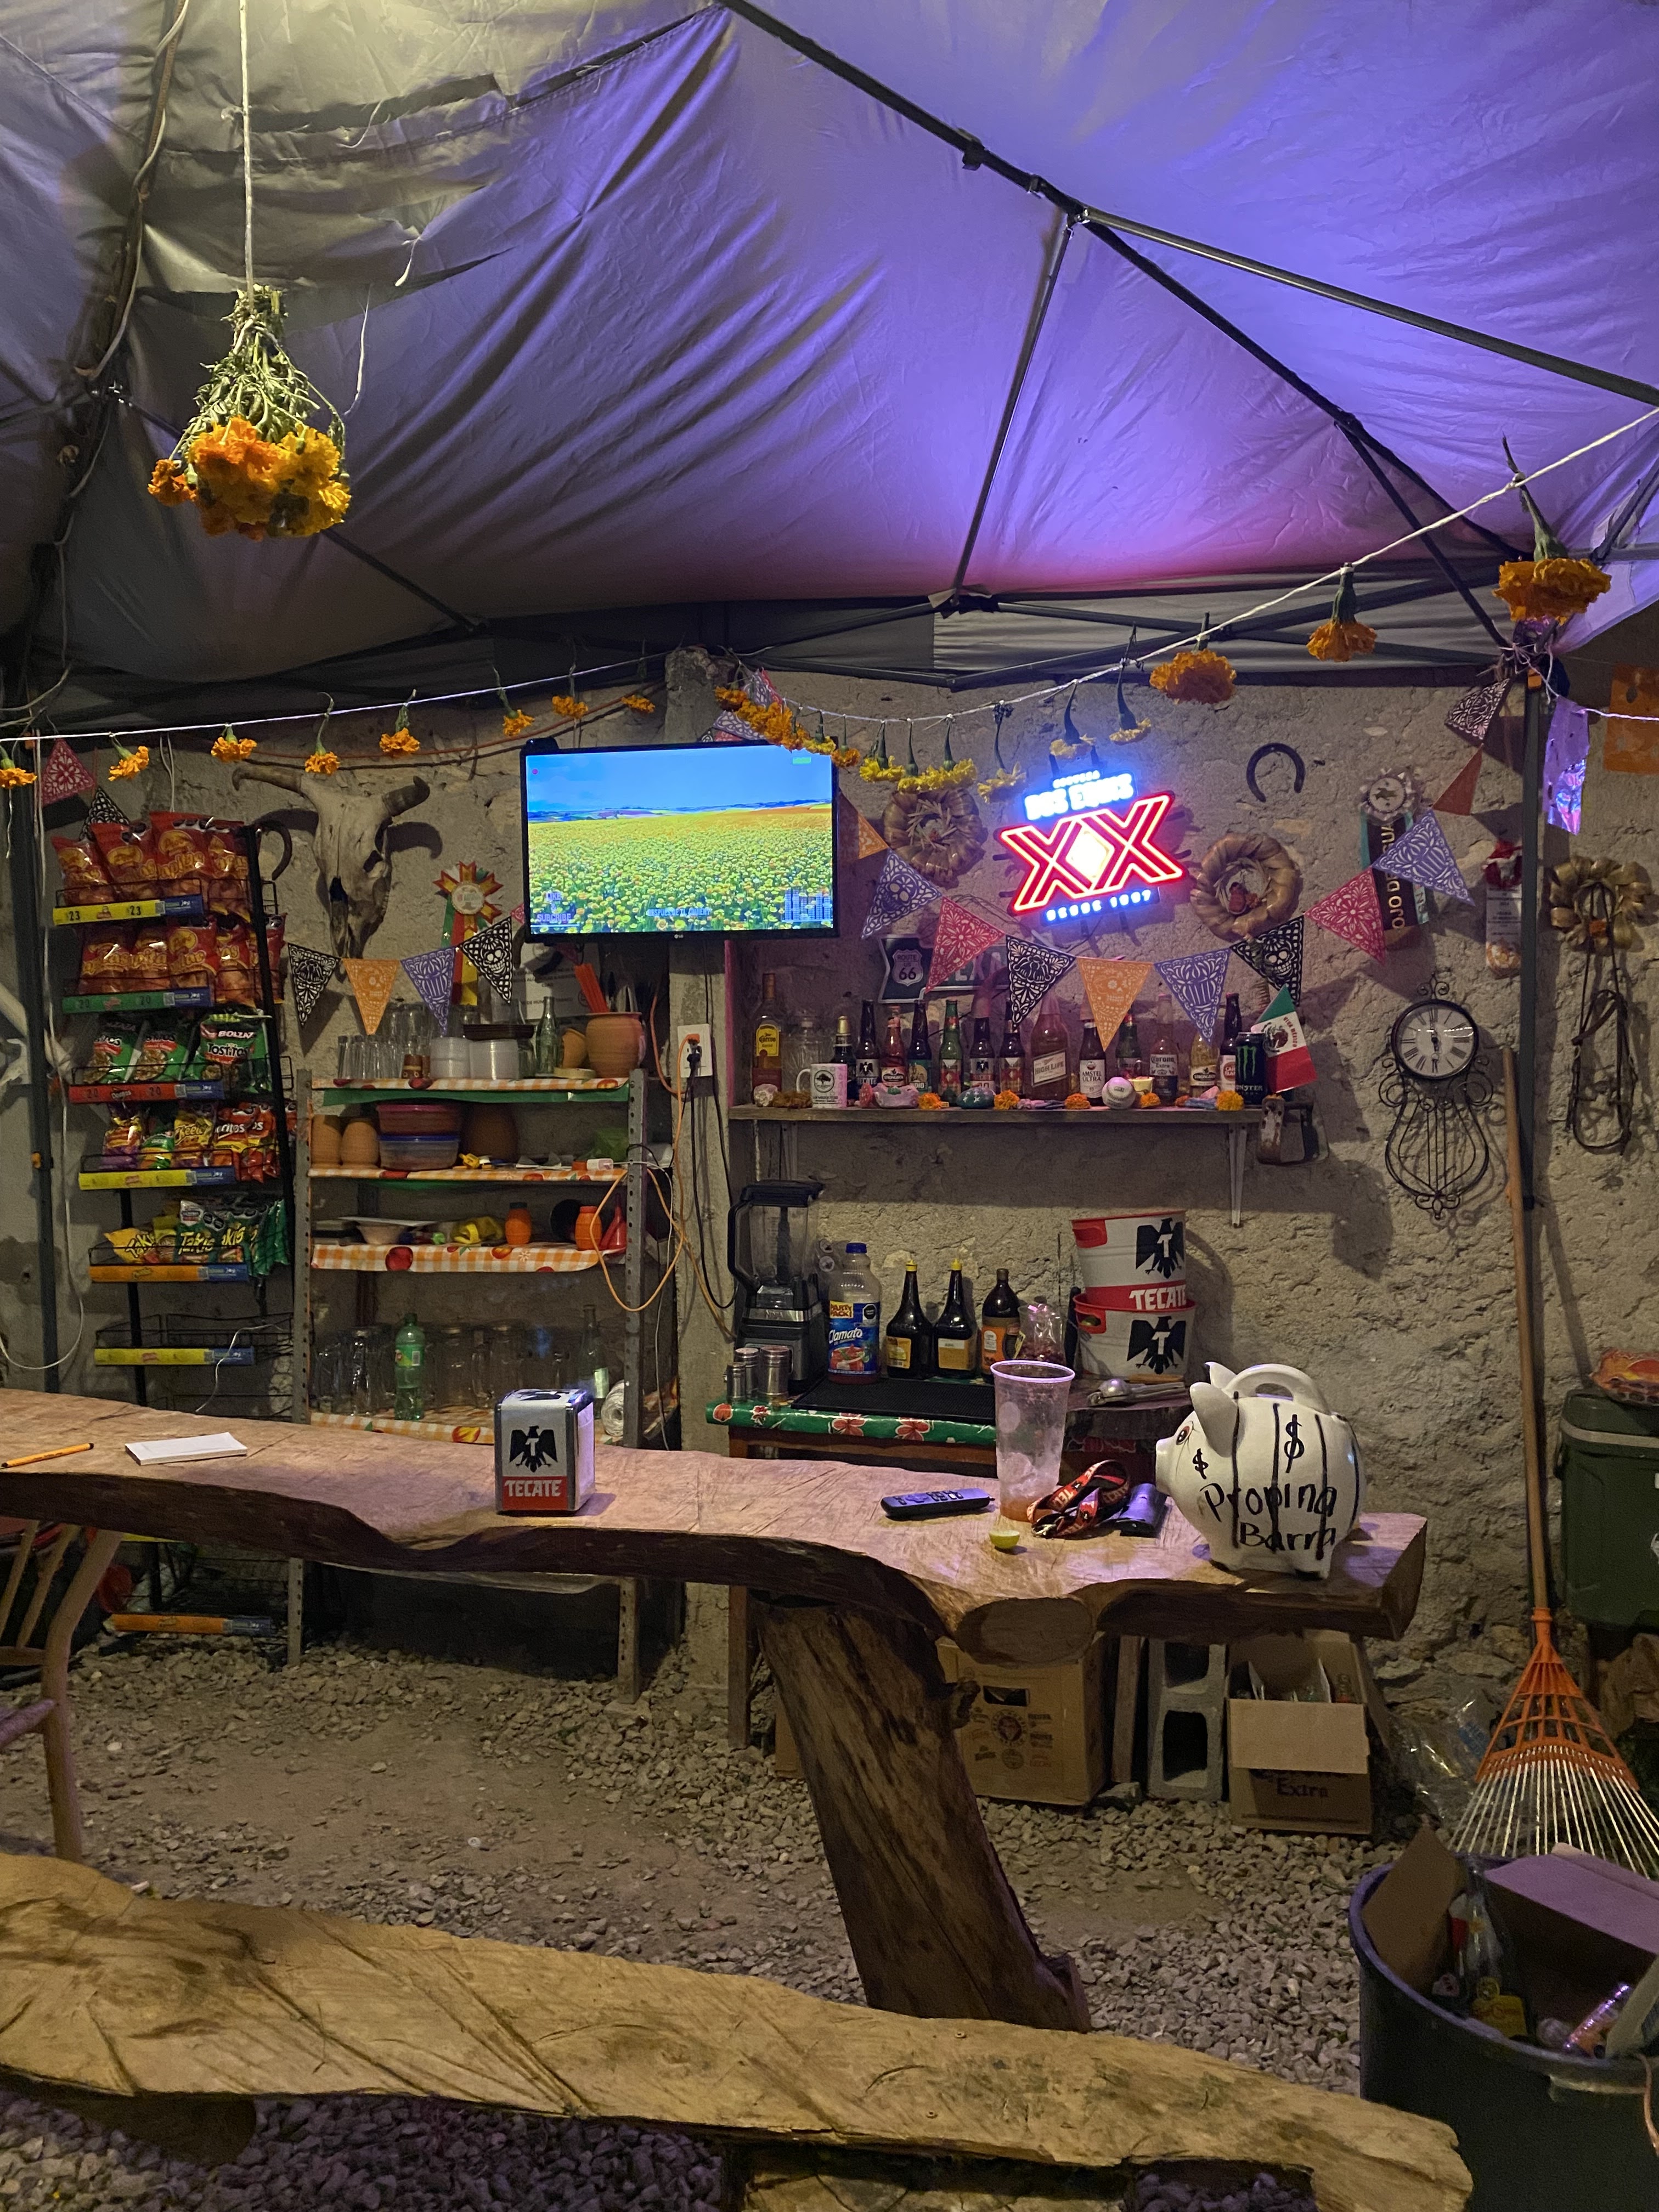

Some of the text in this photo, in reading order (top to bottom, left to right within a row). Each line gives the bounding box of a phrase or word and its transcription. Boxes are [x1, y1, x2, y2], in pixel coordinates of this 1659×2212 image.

[997, 793, 1185, 913] XX
[899, 967, 917, 980] 66
[1035, 1064, 1050, 1075] HIGH
[178, 1231, 216, 1255] Takis
[1128, 1284, 1187, 1311] TECATE
[828, 1327, 863, 1344] Clamato
[504, 1479, 562, 1498] TECATE
[1199, 1483, 1338, 1522] Propina
[1277, 1778, 1329, 1798] Extra
